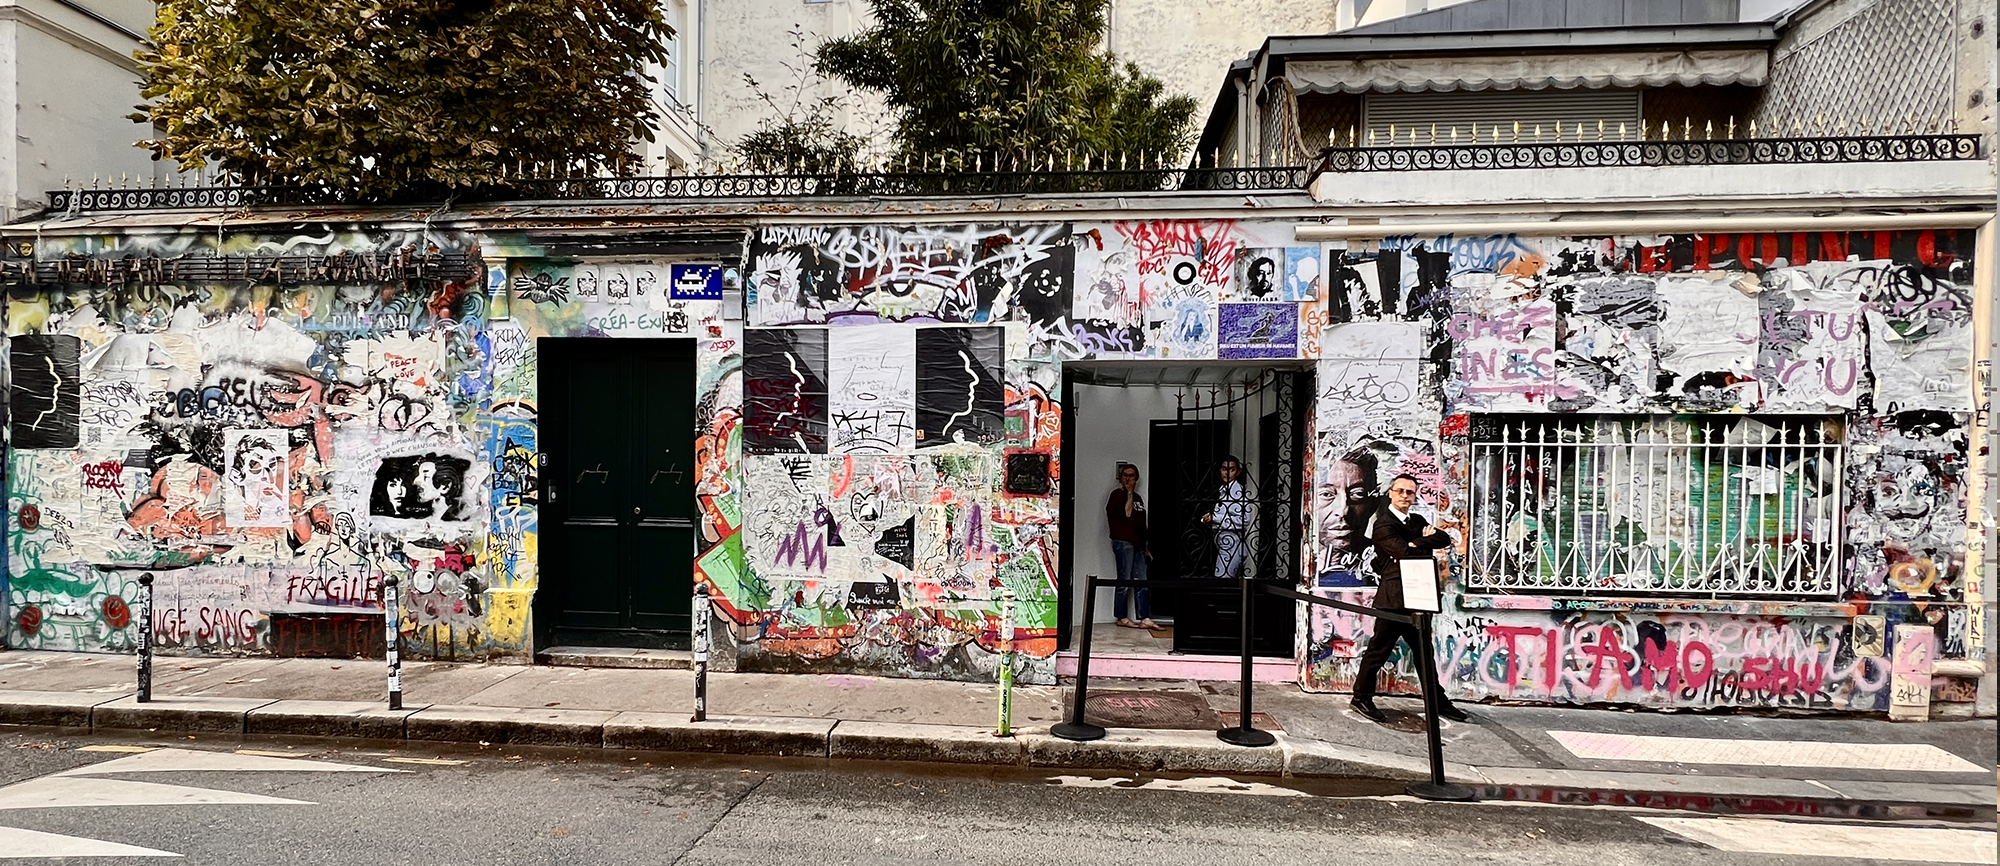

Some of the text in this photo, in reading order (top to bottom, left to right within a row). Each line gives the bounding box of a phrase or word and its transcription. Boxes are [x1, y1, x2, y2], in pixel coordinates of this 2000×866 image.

[390, 358, 417, 368] PEACE
[394, 369, 415, 378] LOVE
[287, 574, 379, 607] FRAGILE
[153, 608, 190, 640] UGE
[198, 606, 257, 642] SANG
